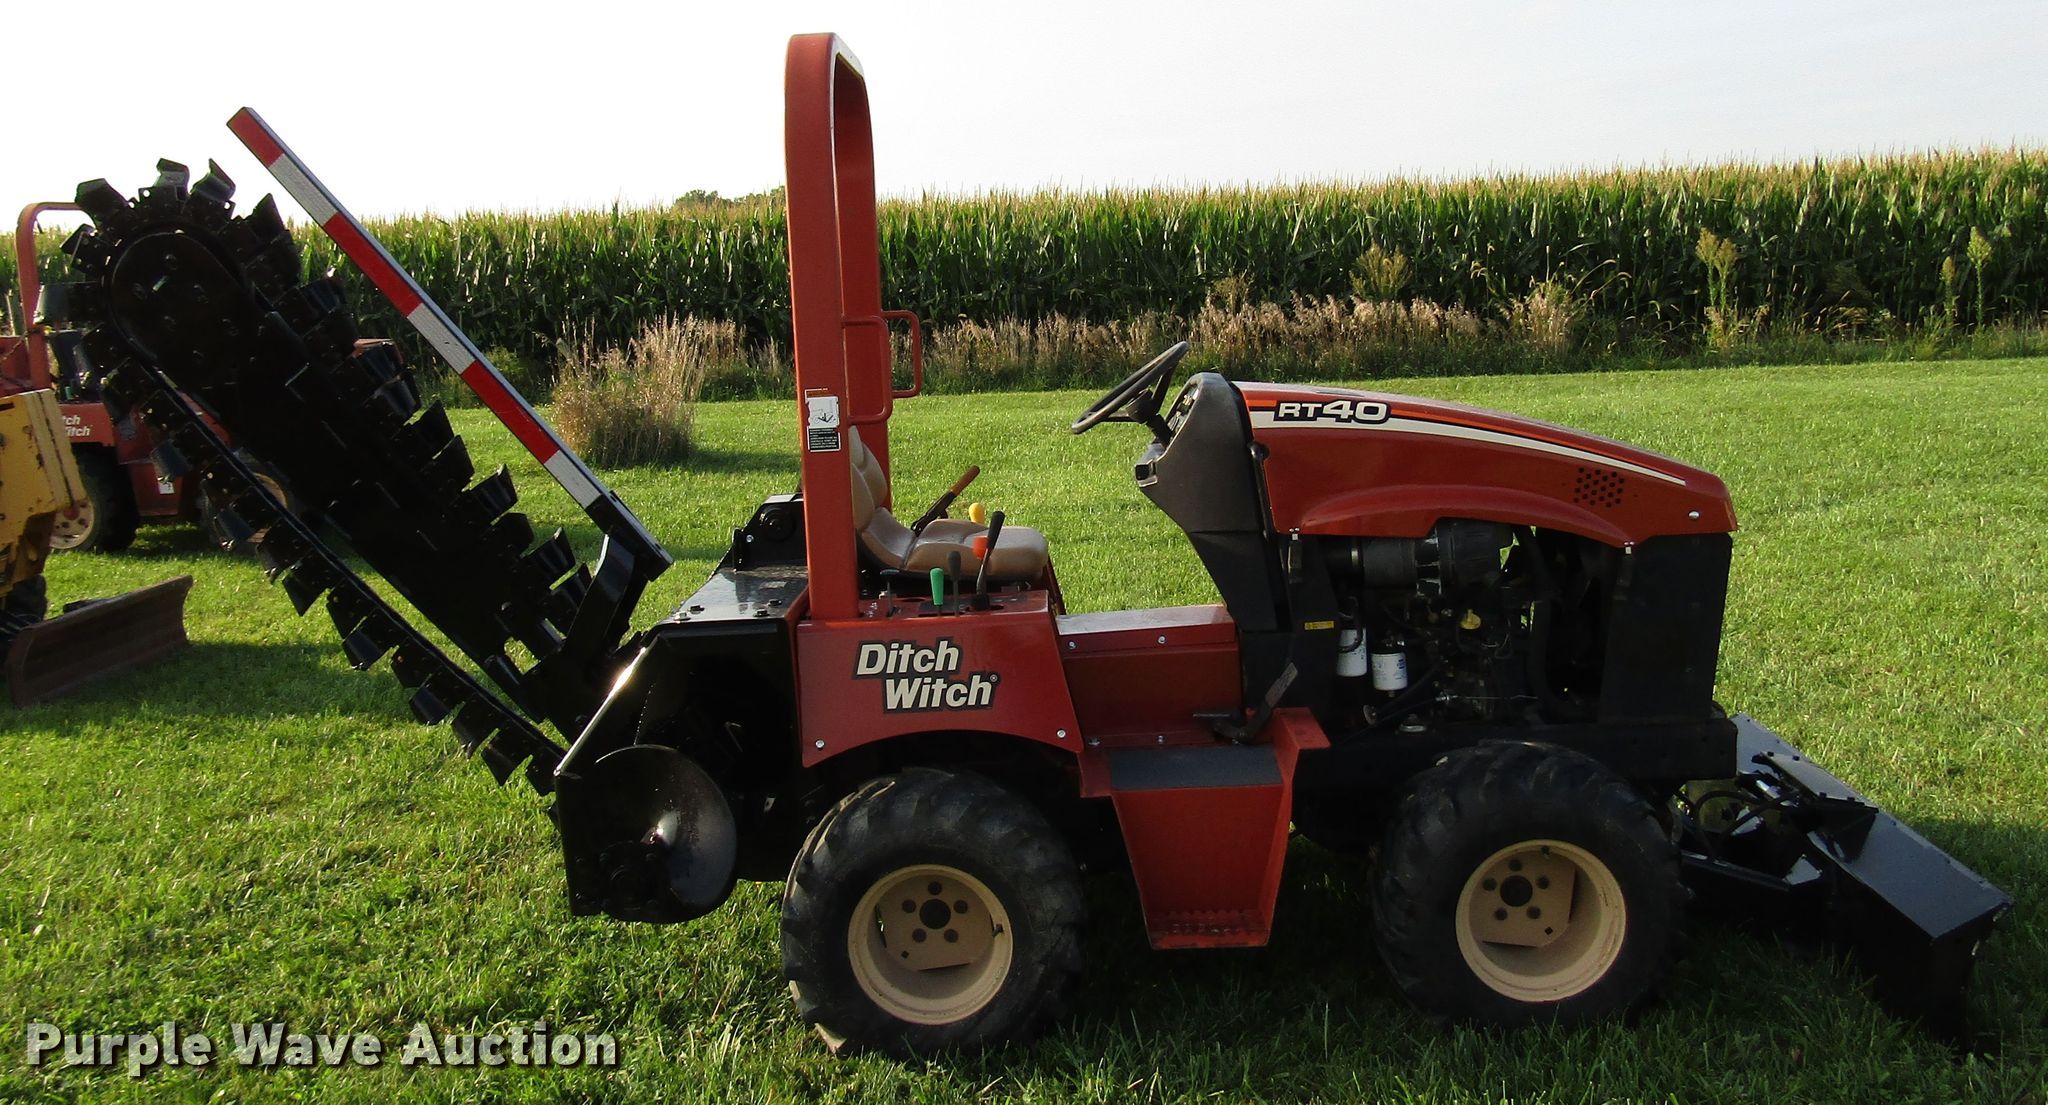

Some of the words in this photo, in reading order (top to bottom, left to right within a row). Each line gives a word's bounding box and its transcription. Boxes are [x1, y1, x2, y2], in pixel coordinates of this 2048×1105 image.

[1278, 400, 1388, 421] RT40
[65, 426, 91, 437] itch
[856, 640, 959, 675] Ditch
